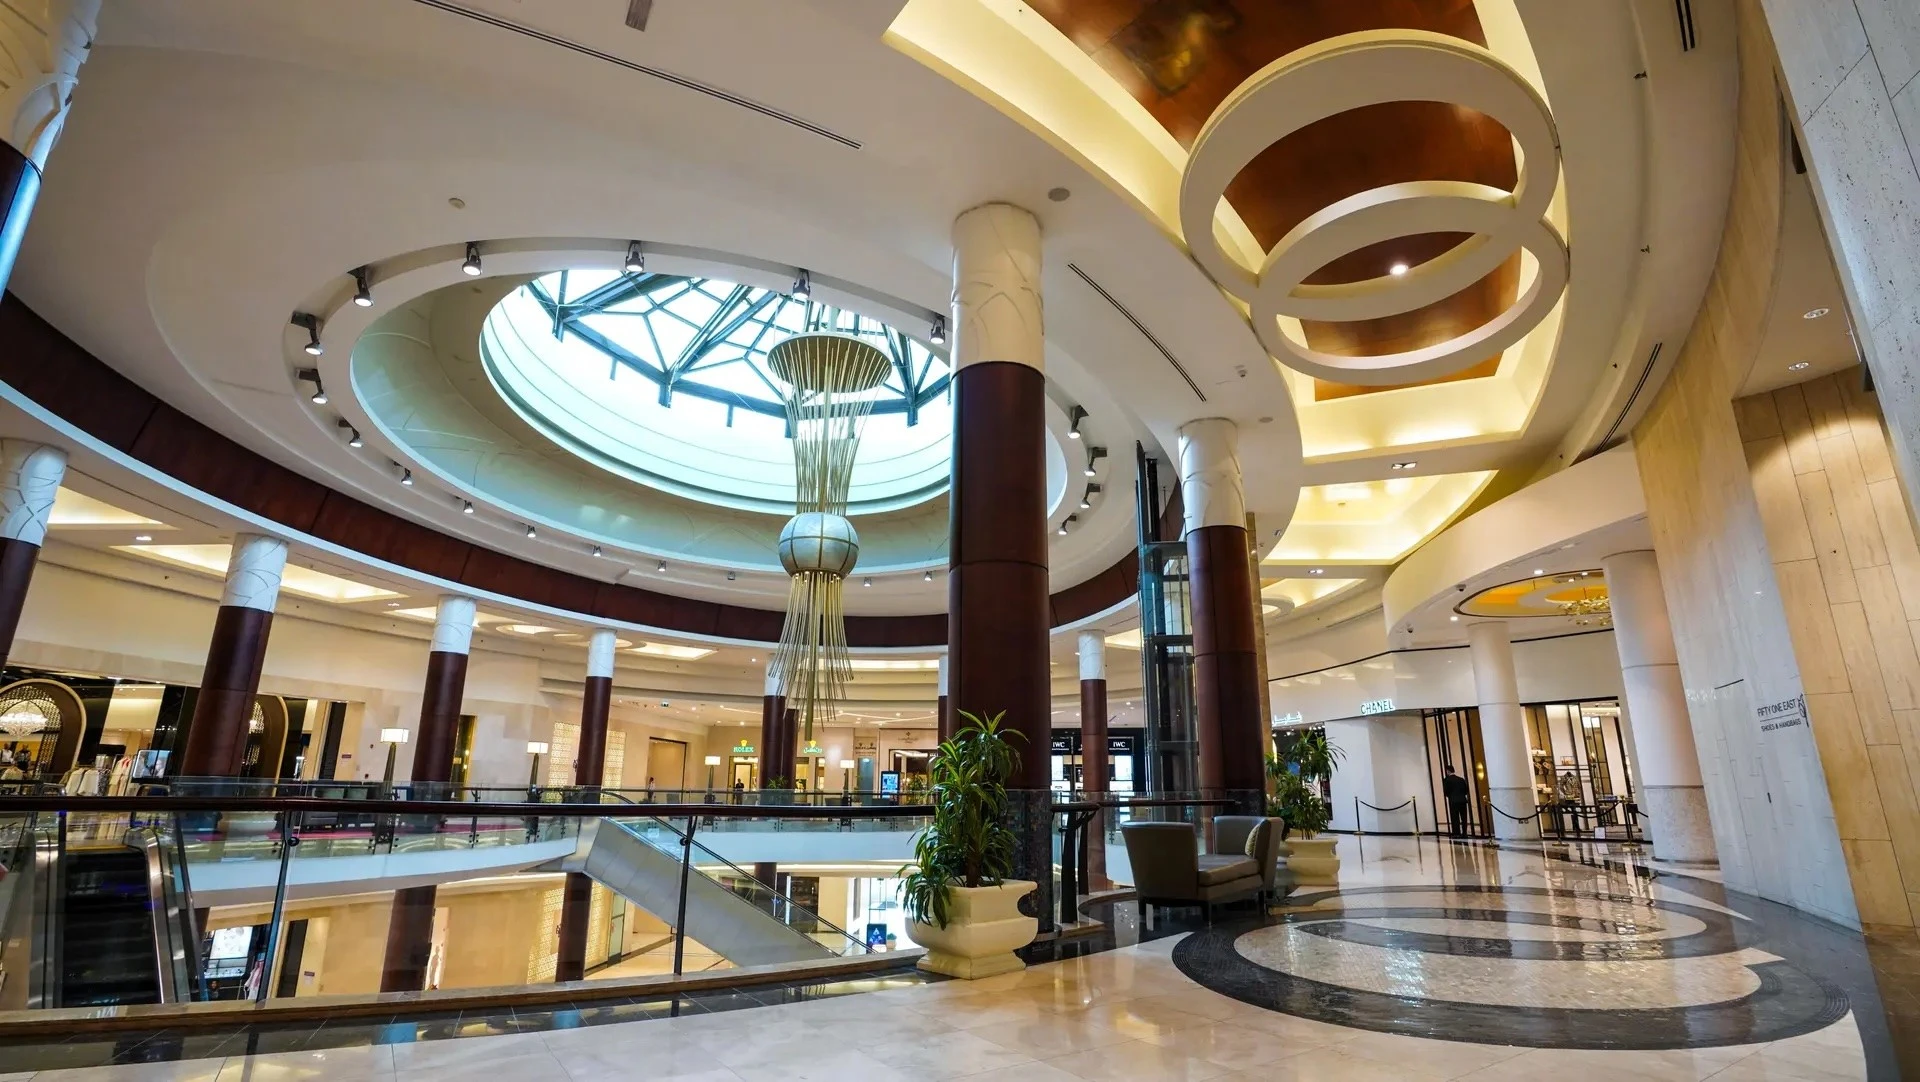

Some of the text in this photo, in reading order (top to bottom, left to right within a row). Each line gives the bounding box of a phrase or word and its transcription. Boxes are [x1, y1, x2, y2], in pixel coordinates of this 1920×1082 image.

[1360, 699, 1395, 715] CHANEL
[1772, 703, 1783, 713] ONE
[1783, 699, 1795, 710] EAST
